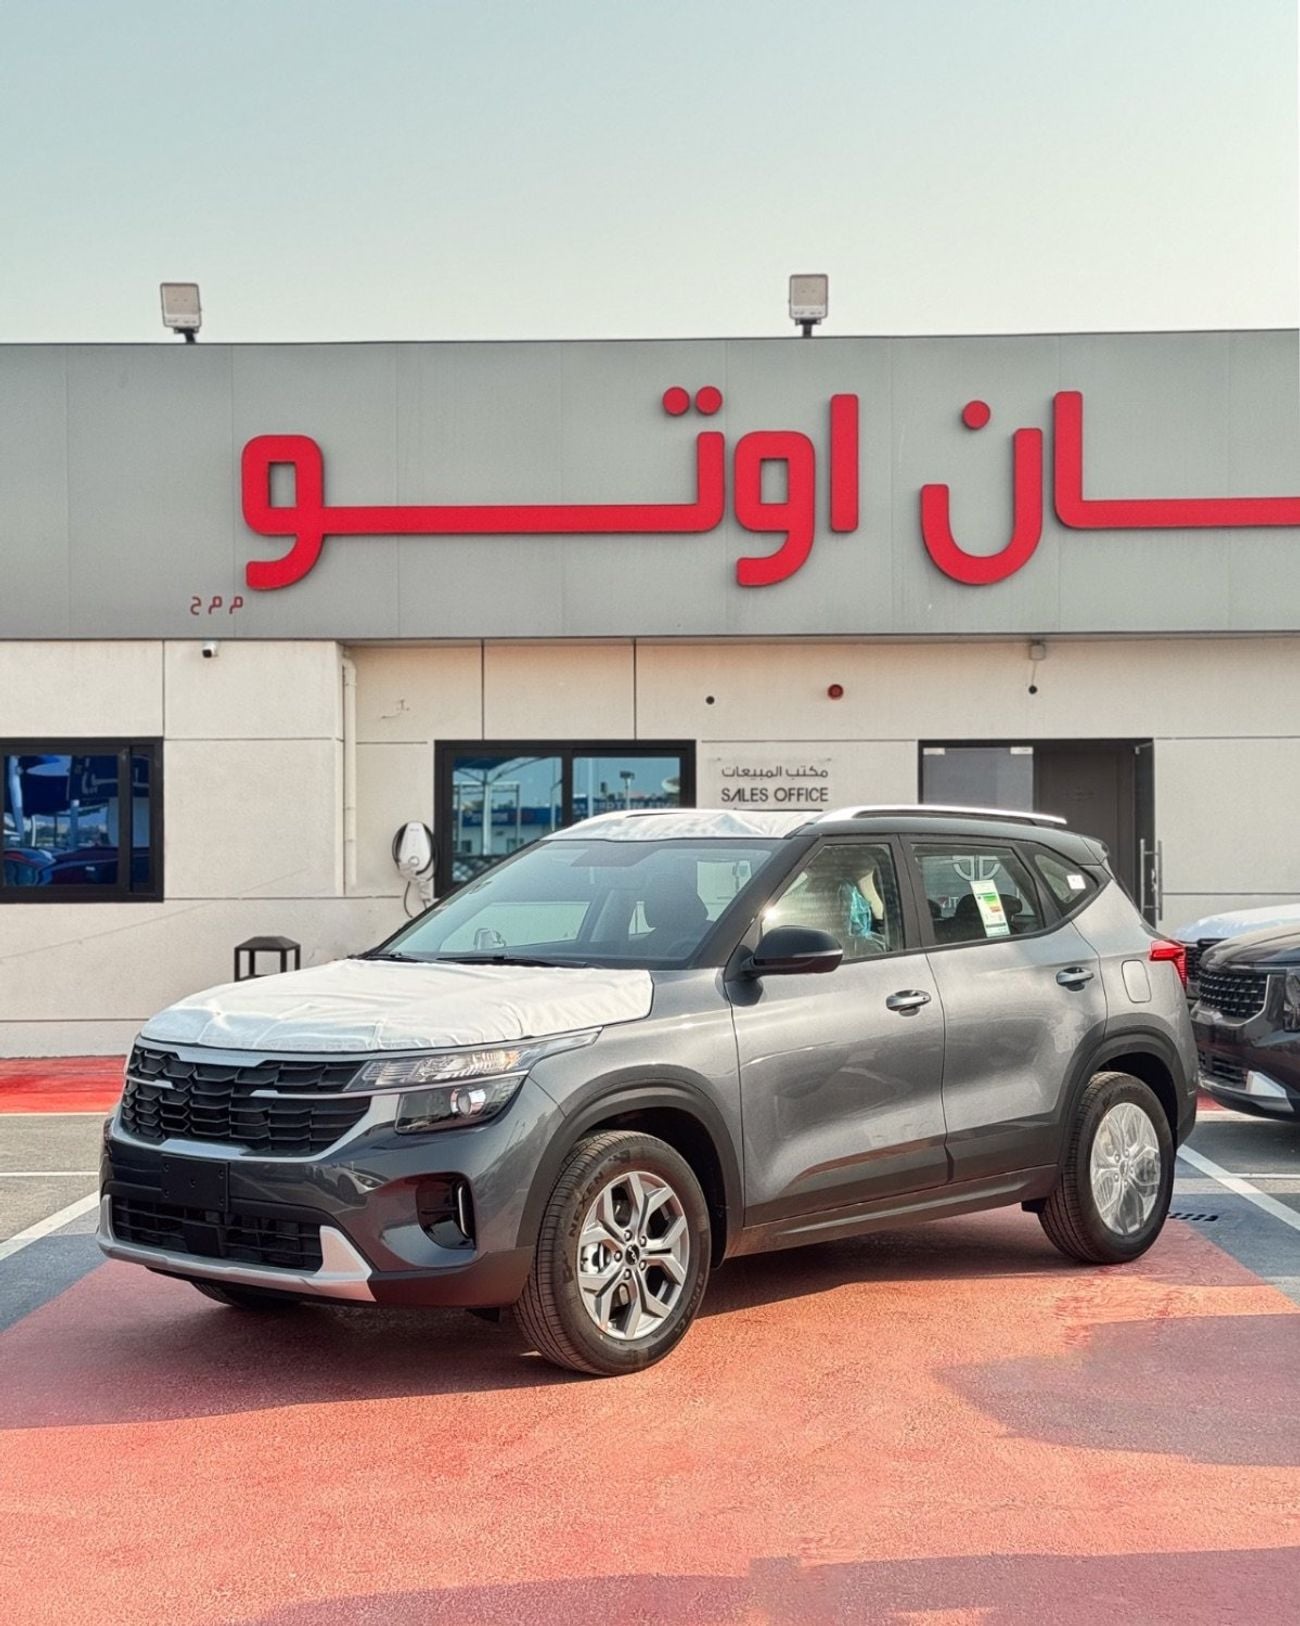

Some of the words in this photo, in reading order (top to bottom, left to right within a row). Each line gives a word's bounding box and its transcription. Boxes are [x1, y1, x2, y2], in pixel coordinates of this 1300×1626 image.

[241, 387, 860, 590] اوتو
[721, 765, 782, 781] المبيعات
[785, 764, 829, 781] مكتب
[721, 787, 769, 803] SALES
[773, 787, 829, 803] OFFICE
[567, 1171, 604, 1238] NEXEN
